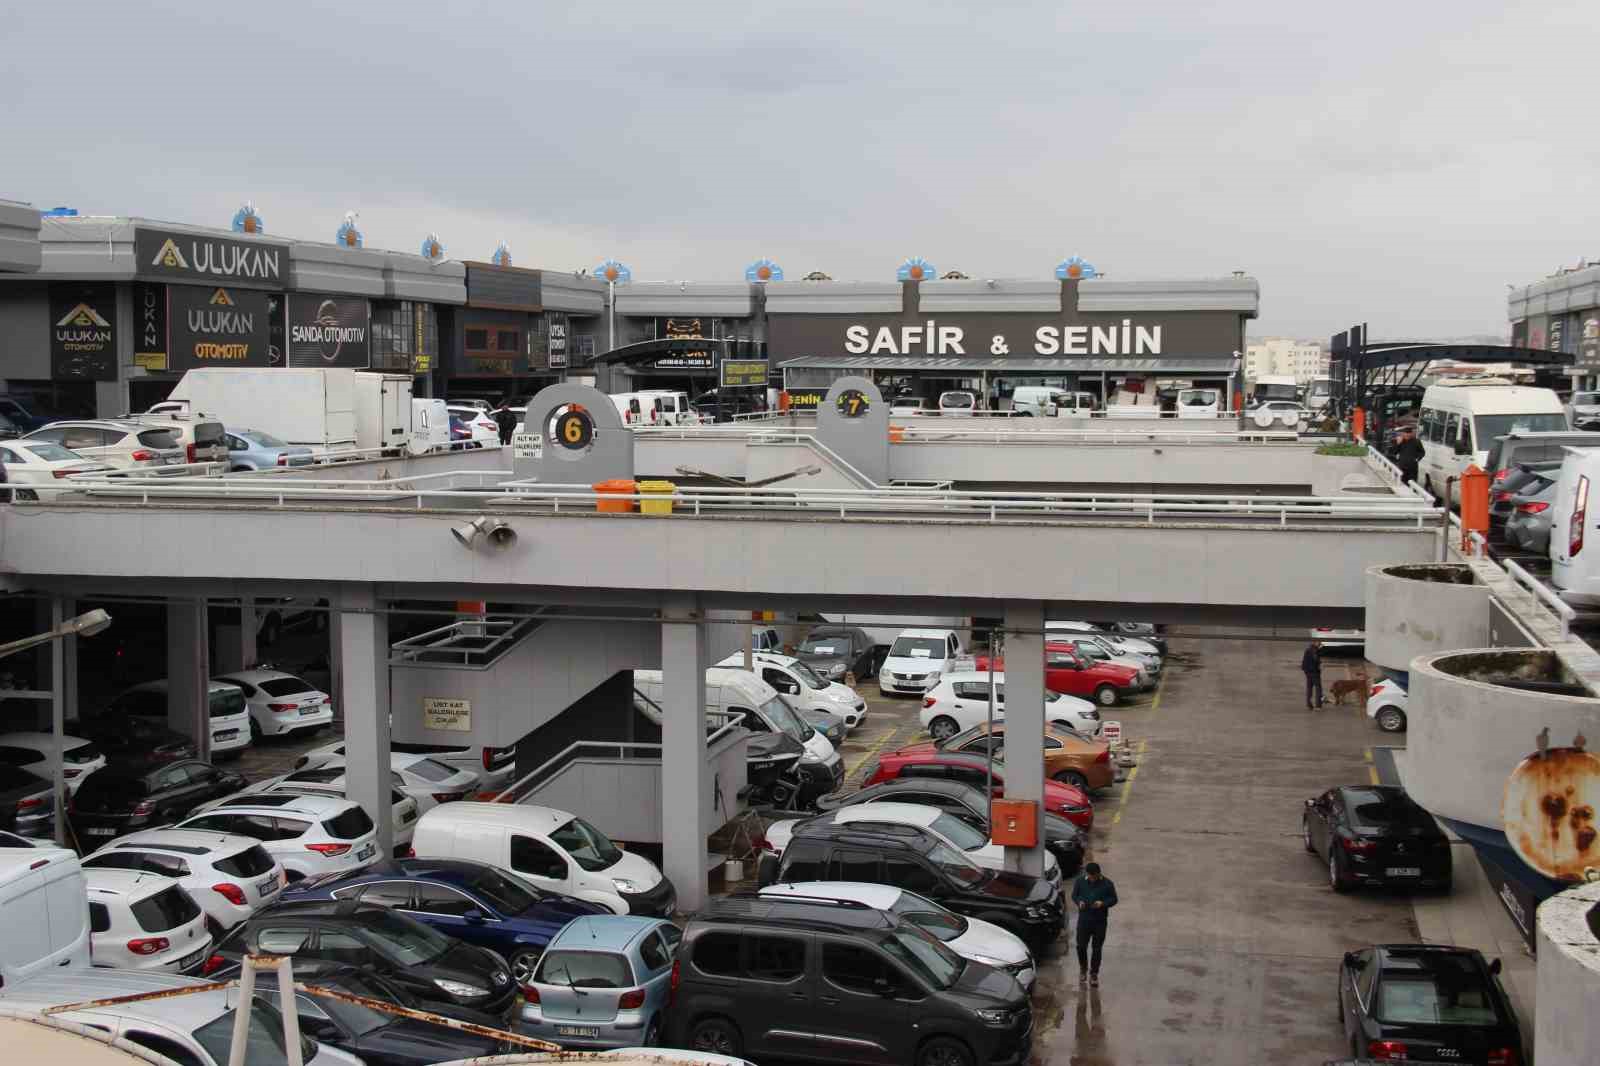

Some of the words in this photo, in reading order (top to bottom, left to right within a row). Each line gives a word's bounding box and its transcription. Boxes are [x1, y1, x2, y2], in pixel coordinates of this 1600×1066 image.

[192, 241, 280, 279] ULUKAN
[187, 309, 254, 334] ULUKAN
[56, 327, 111, 343] ULUKAN
[291, 326, 323, 343] SANDA
[844, 320, 964, 354] SAFİR
[989, 335, 1010, 355] &
[1034, 319, 1162, 354] SENİN
[849, 399, 860, 416] 7
[564, 417, 581, 443] 6
